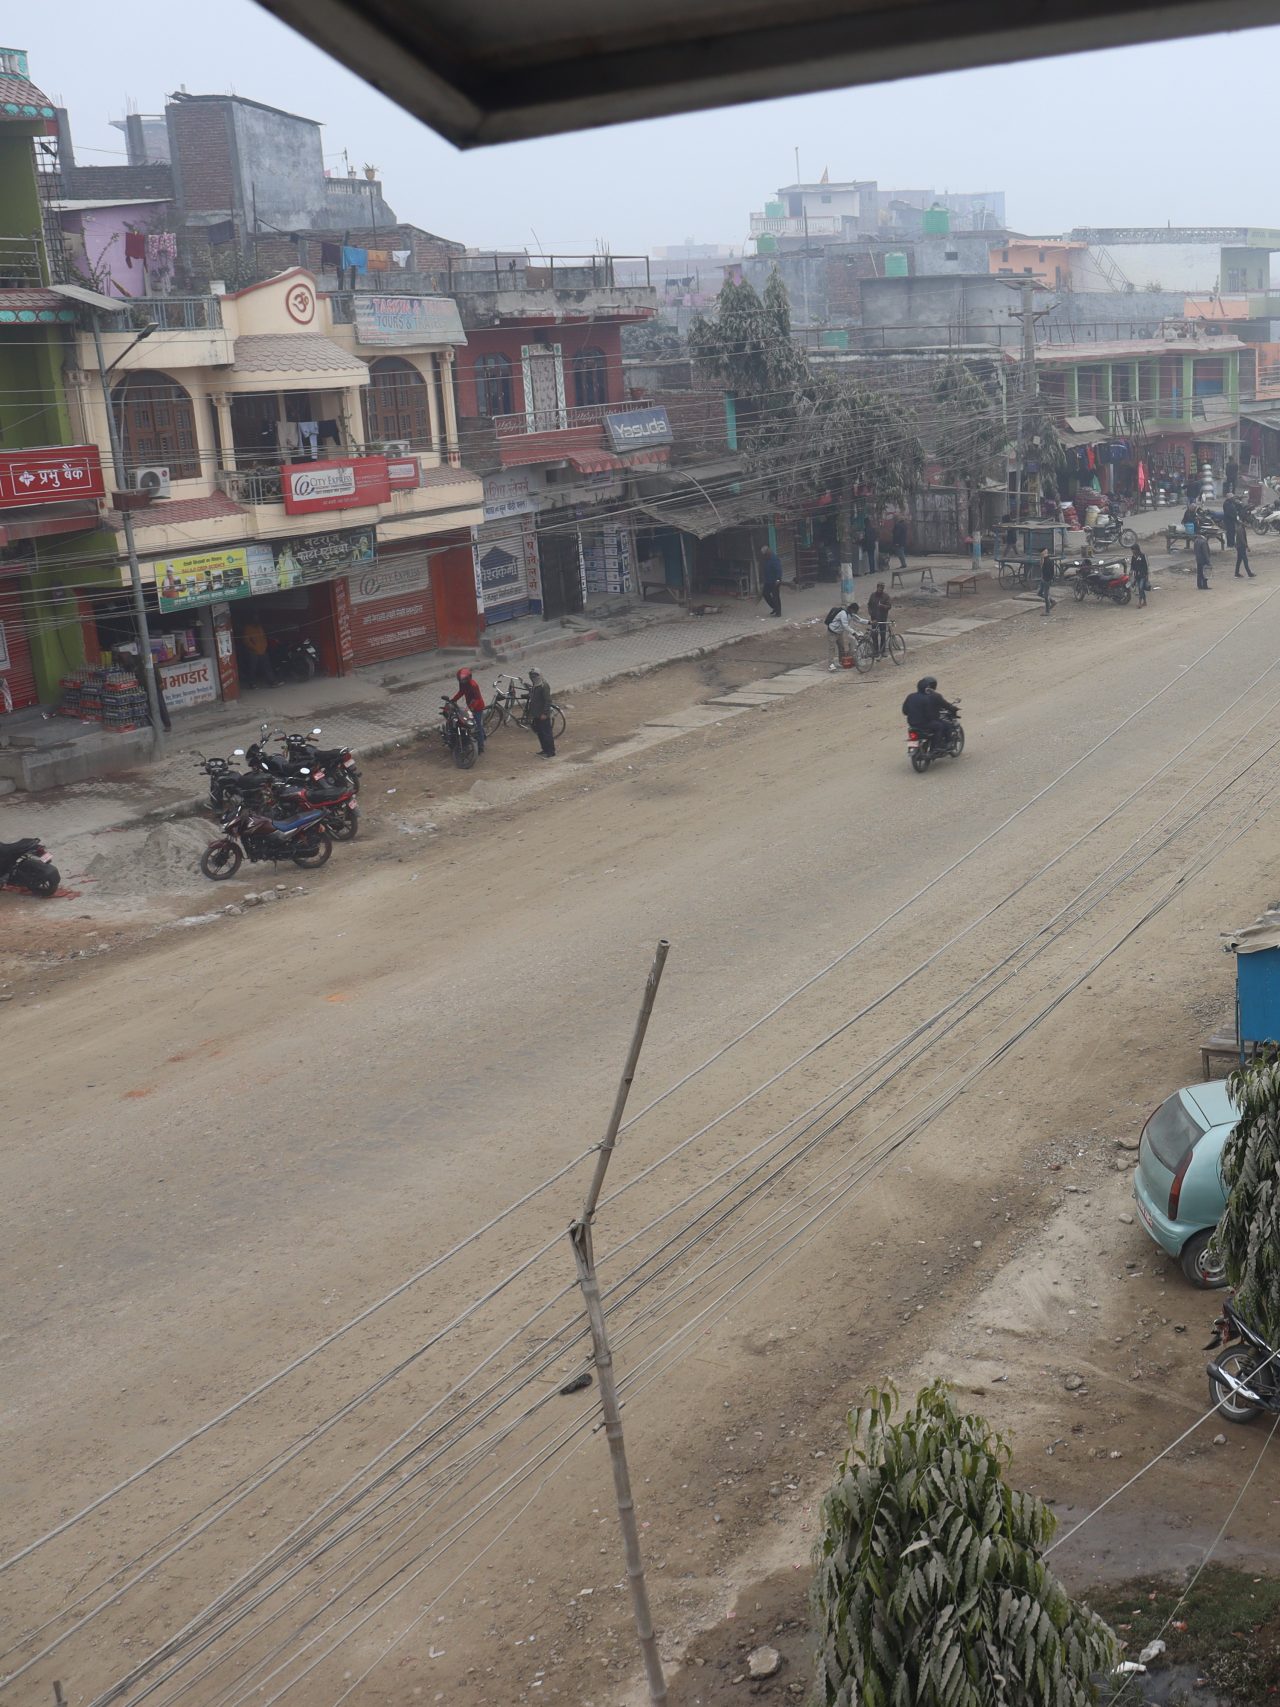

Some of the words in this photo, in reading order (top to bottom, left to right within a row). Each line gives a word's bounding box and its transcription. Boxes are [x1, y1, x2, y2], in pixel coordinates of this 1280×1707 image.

[376, 314, 404, 329] TOURS
[614, 417, 668, 438] Yasuda
[37, 469, 61, 488] प्रभु
[62, 463, 84, 481] बैंक
